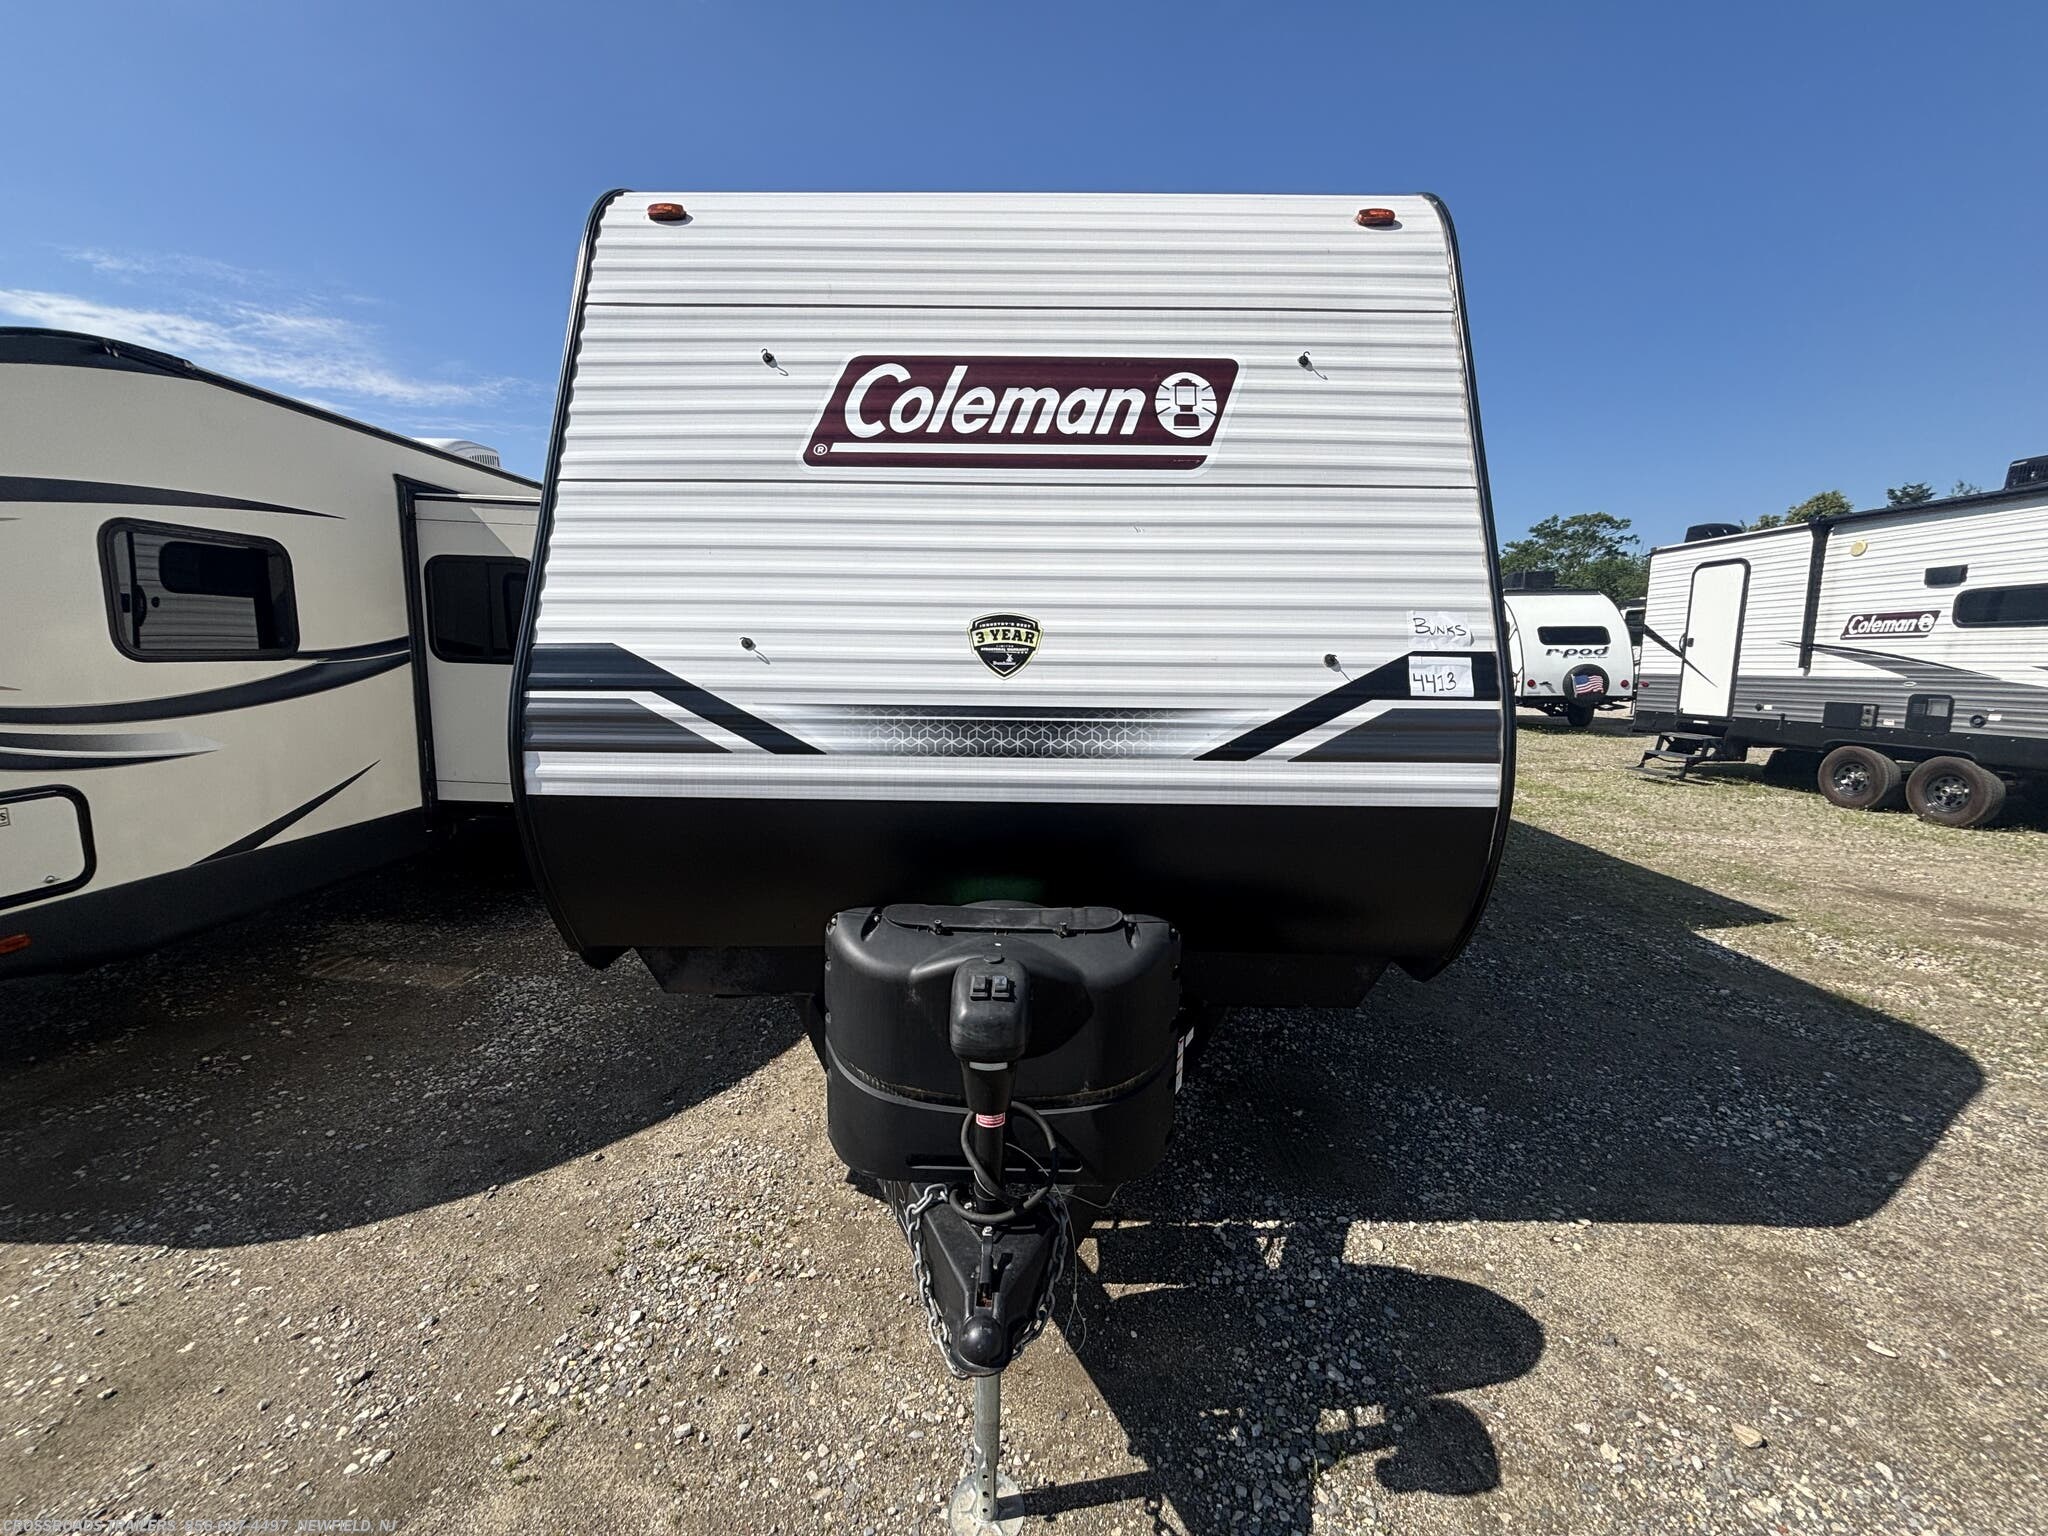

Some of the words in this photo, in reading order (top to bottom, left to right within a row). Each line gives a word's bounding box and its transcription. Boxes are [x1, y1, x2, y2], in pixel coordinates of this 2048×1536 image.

[844, 362, 1146, 438] Coleman
[1848, 615, 1918, 635] Coleman
[975, 631, 985, 643] 3
[989, 629, 1035, 644] YEAR
[1412, 671, 1457, 693] 4413
